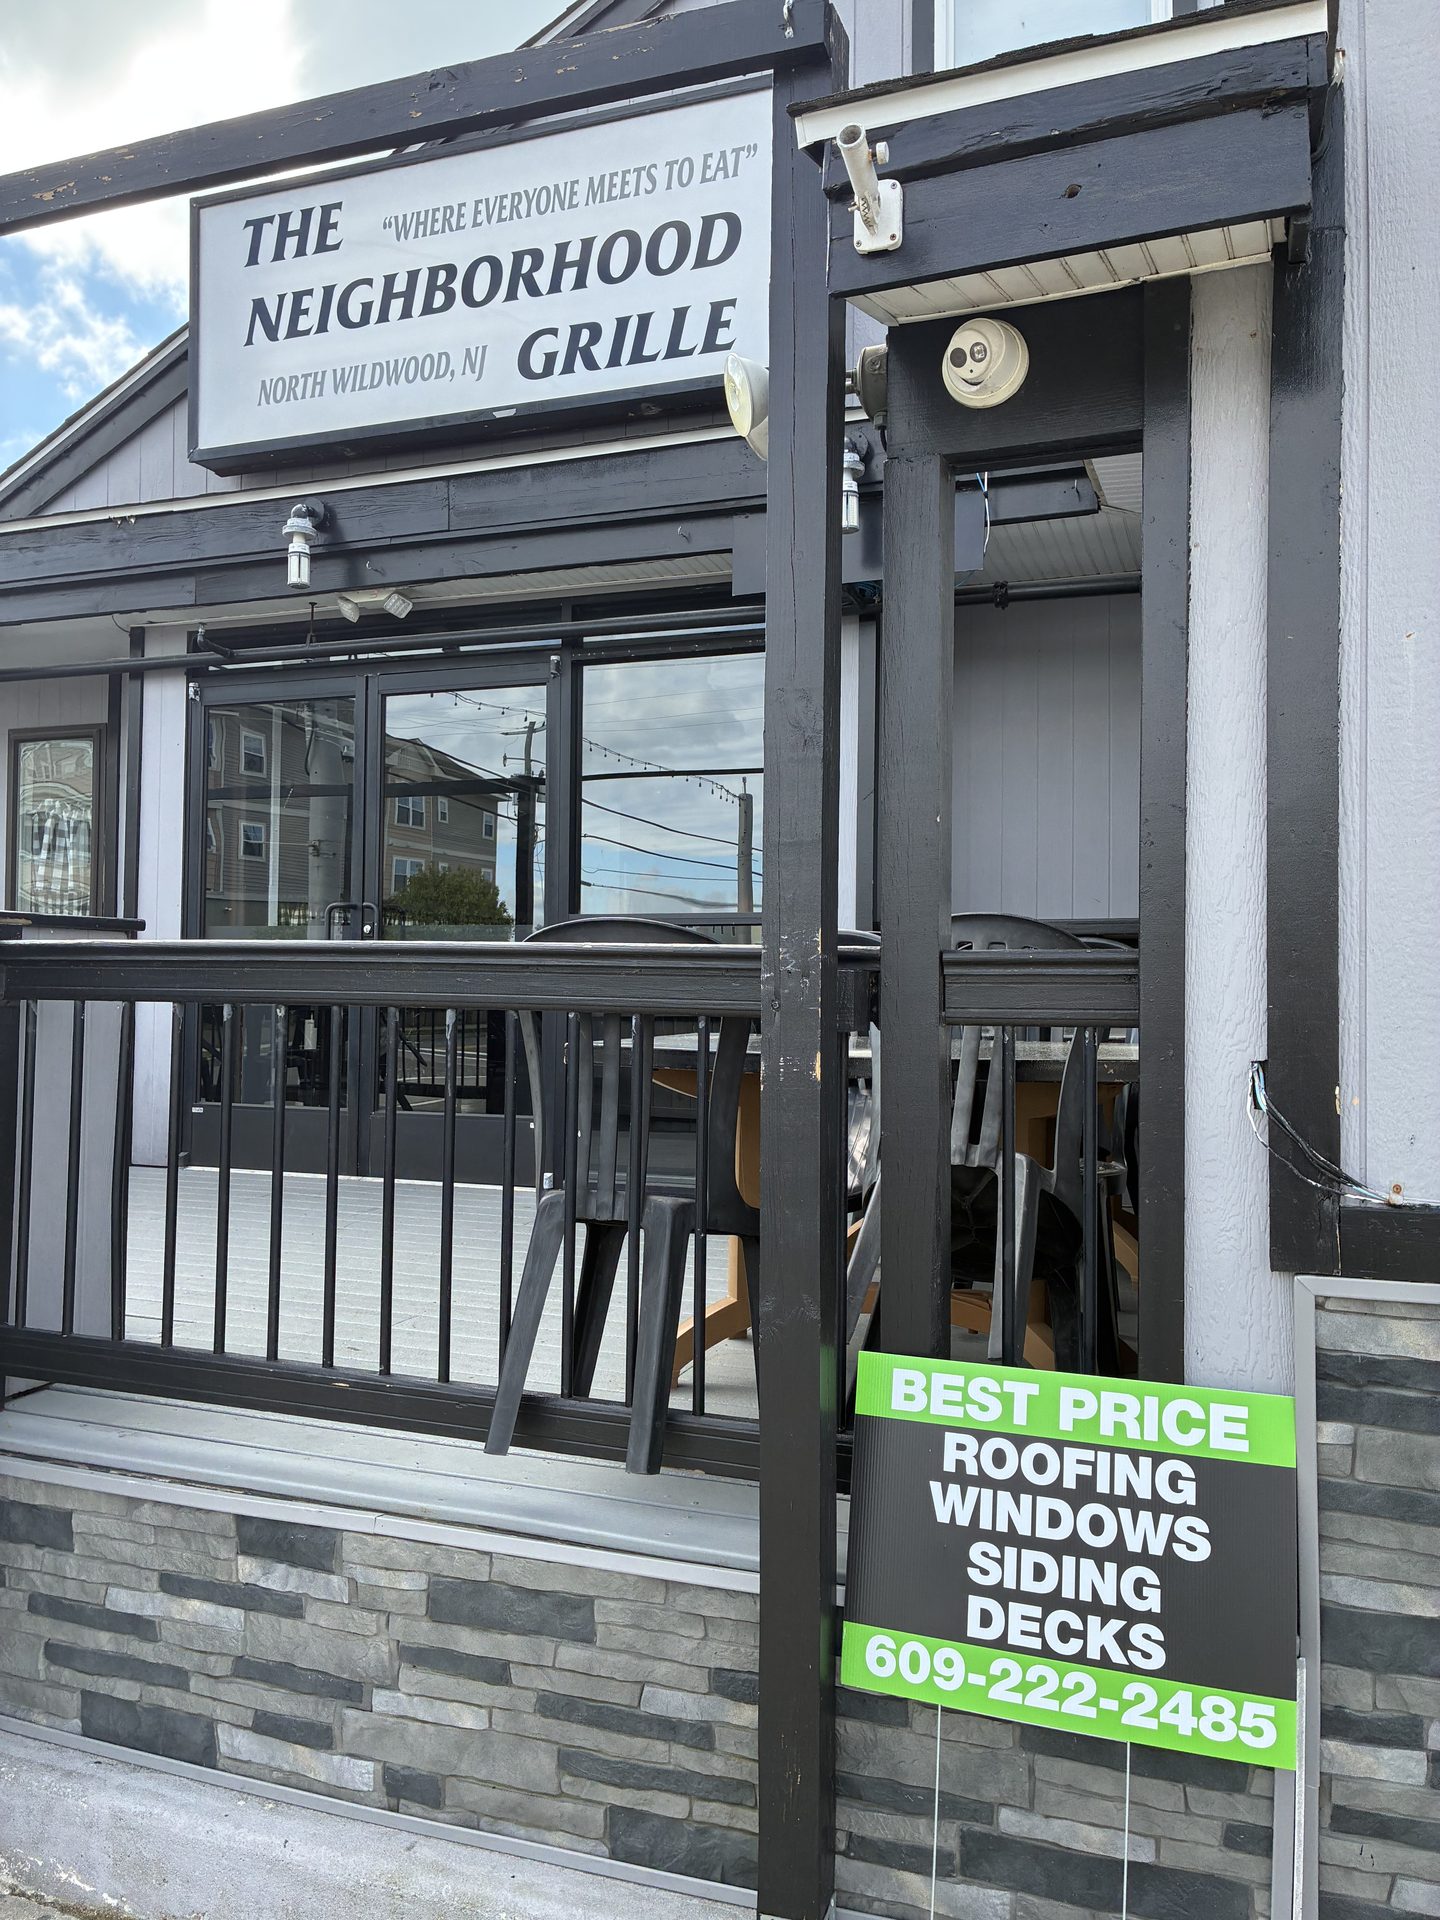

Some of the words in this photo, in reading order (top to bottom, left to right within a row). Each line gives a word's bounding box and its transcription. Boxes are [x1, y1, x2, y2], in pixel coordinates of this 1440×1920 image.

[382, 201, 467, 242] “WHERE
[472, 179, 580, 225] EVERYONE
[585, 165, 658, 206] MEETS
[664, 158, 694, 192] TO
[700, 143, 758, 184] EAT”
[243, 201, 343, 268] THE
[244, 211, 742, 347] NEIGHBORHOOD
[257, 369, 327, 407] NORTH
[332, 350, 455, 399] WILDWOOD,
[461, 345, 488, 382] NJ
[517, 298, 737, 380] GRILLE
[891, 1367, 1040, 1426] BEST
[1059, 1386, 1250, 1453] PRICE
[943, 1432, 1197, 1506] ROOFING
[929, 1481, 1212, 1563] WINDOWS
[967, 1541, 1162, 1614] SIDING
[966, 1594, 1167, 1671] DECKS
[865, 1635, 1278, 1750] 609-222-2485
